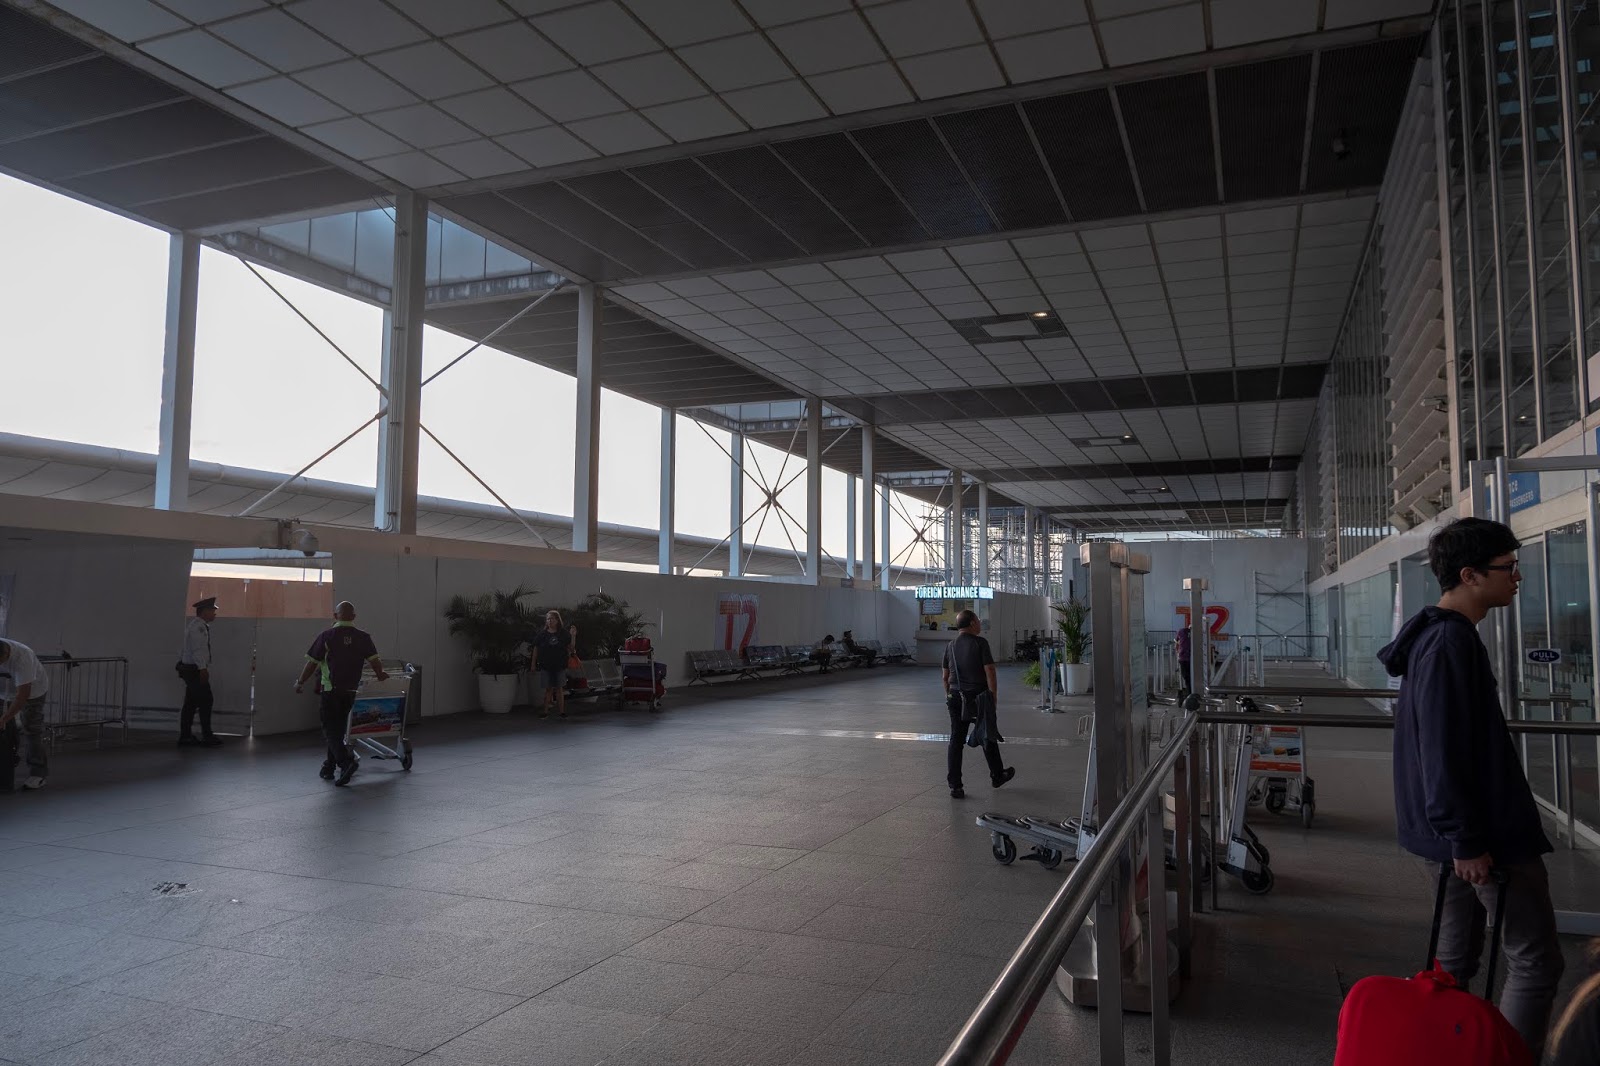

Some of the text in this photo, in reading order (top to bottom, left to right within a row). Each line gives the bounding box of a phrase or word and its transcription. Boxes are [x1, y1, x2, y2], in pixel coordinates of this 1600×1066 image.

[1509, 490, 1534, 507] ASSENGERS
[915, 586, 942, 598] FOREIGN
[943, 586, 978, 599] EXCHANGE
[1532, 651, 1555, 659] PULL
